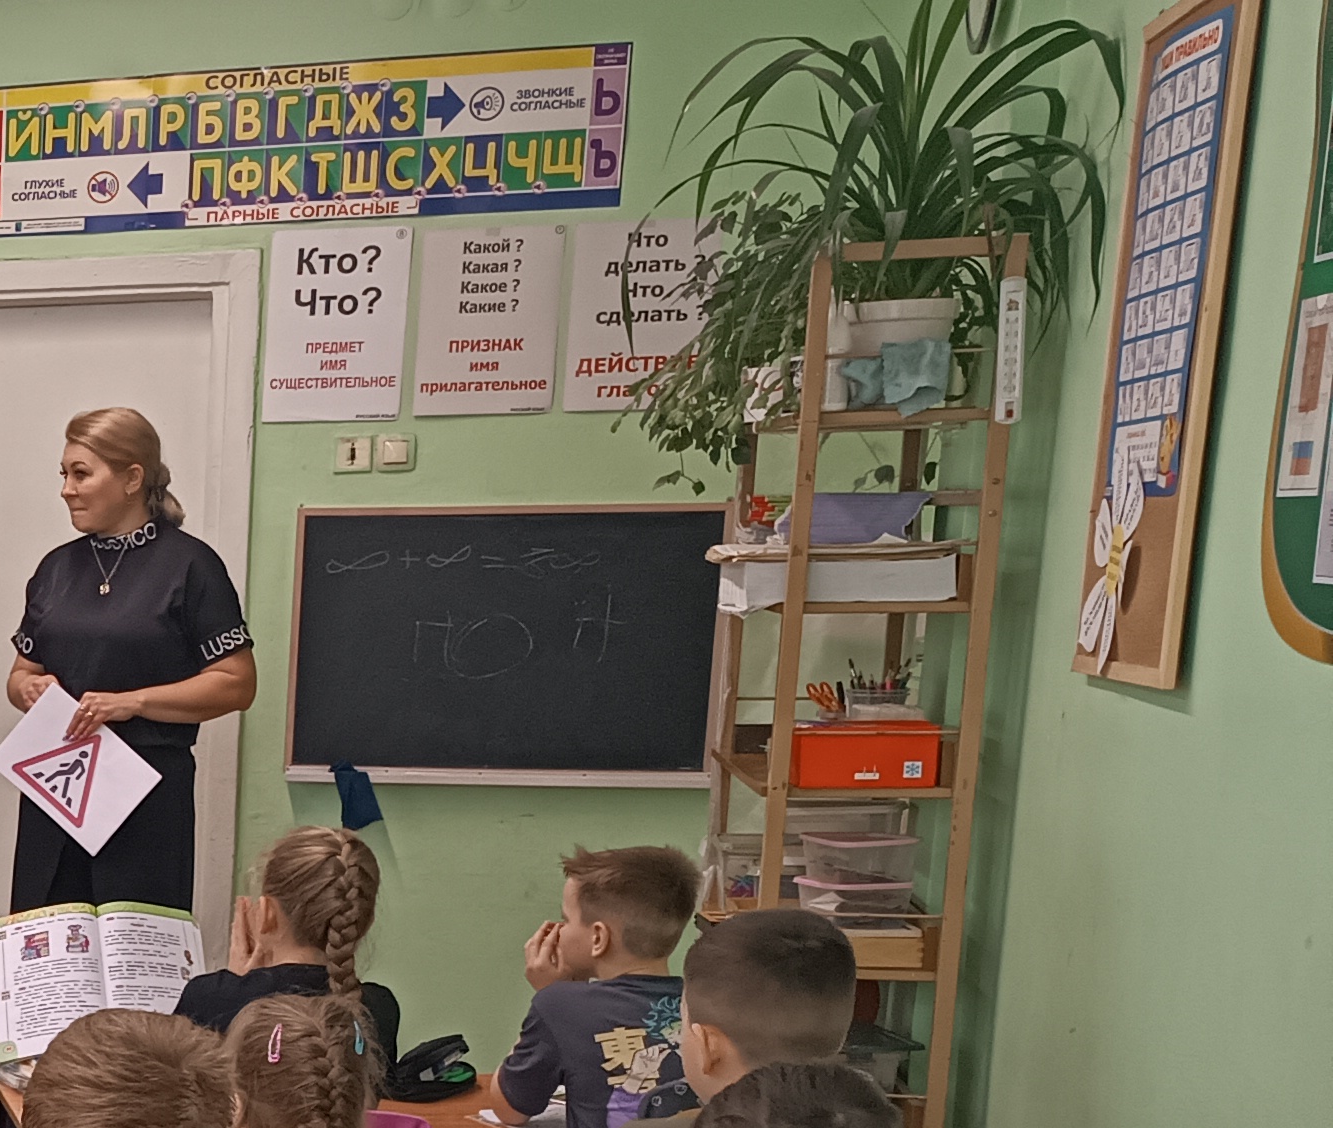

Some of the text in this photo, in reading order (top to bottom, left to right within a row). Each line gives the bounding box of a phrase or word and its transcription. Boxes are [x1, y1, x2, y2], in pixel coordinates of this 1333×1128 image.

[204, 65, 351, 91] СОГЛАСНЫЕ
[516, 86, 575, 100] ЗВОНКИЕ
[510, 97, 586, 113] СОГЛАСНЫЕ
[24, 178, 65, 190] ГЛУХИЕ
[11, 188, 78, 202] СОГЛАСНЫЕ
[206, 200, 400, 223] ПАРНЫЕ СОГЛАСНЫЕ
[463, 239, 511, 255] Какой
[296, 245, 382, 275] Кто?
[462, 260, 509, 275] Какая
[460, 280, 508, 295] Какое
[294, 286, 382, 316] Что?
[458, 300, 506, 315] Какие
[305, 341, 365, 354] ПРЕДМЕТ
[448, 338, 524, 354] ПРИЗНАК
[319, 359, 347, 371] ИМЯ
[469, 361, 499, 372] имя
[269, 375, 396, 390] СУЩЕСТВИТЕЛЬНОЕ
[420, 378, 547, 395] прилагательное
